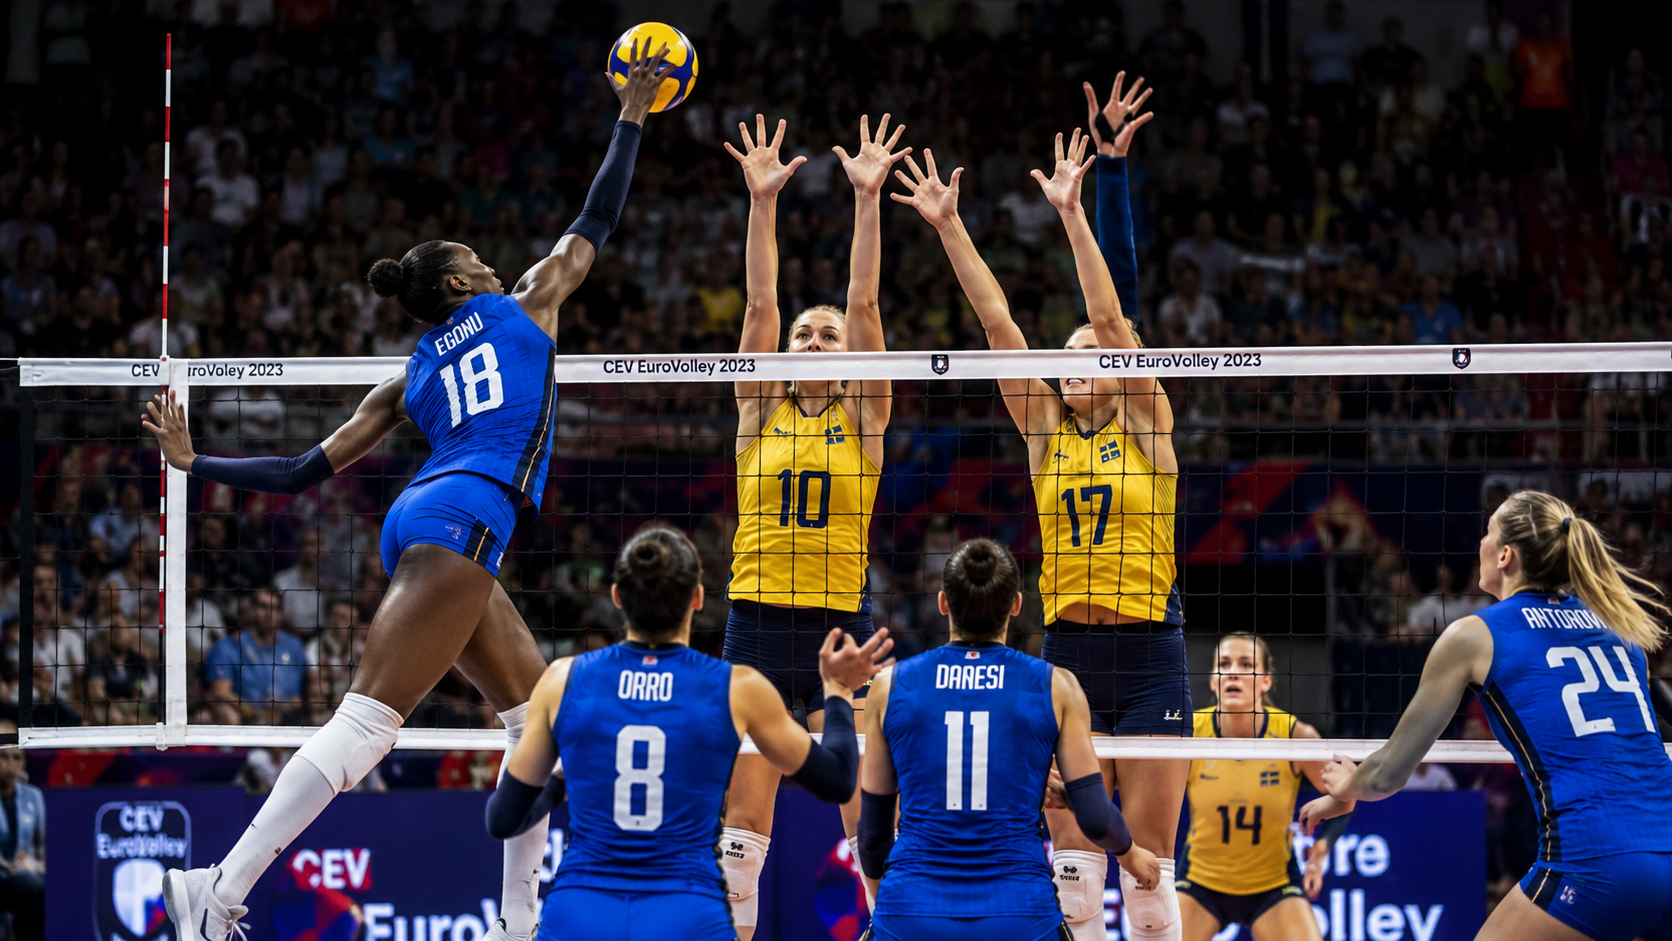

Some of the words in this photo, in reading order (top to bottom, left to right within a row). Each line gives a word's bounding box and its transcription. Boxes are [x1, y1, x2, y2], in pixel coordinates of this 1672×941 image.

[434, 311, 484, 357] EGONU
[131, 363, 160, 377] CEV
[188, 363, 245, 379] roVoley
[248, 363, 283, 377] 2023
[603, 359, 634, 374] CEV
[638, 358, 716, 376] EuroVolley
[719, 358, 756, 373] 2023
[1099, 354, 1132, 369] CEV
[1136, 353, 1219, 370] EuroVolley
[1223, 353, 1262, 367] 2023
[439, 342, 504, 428] 18
[777, 468, 832, 529] 10
[1061, 484, 1113, 548] 17
[618, 669, 674, 702] ORRO
[1545, 645, 1657, 738] 24
[613, 724, 666, 832] 8
[944, 711, 990, 811] 11
[119, 805, 165, 832] CEV
[1216, 805, 1263, 846] 14
[292, 848, 371, 889] CEV
